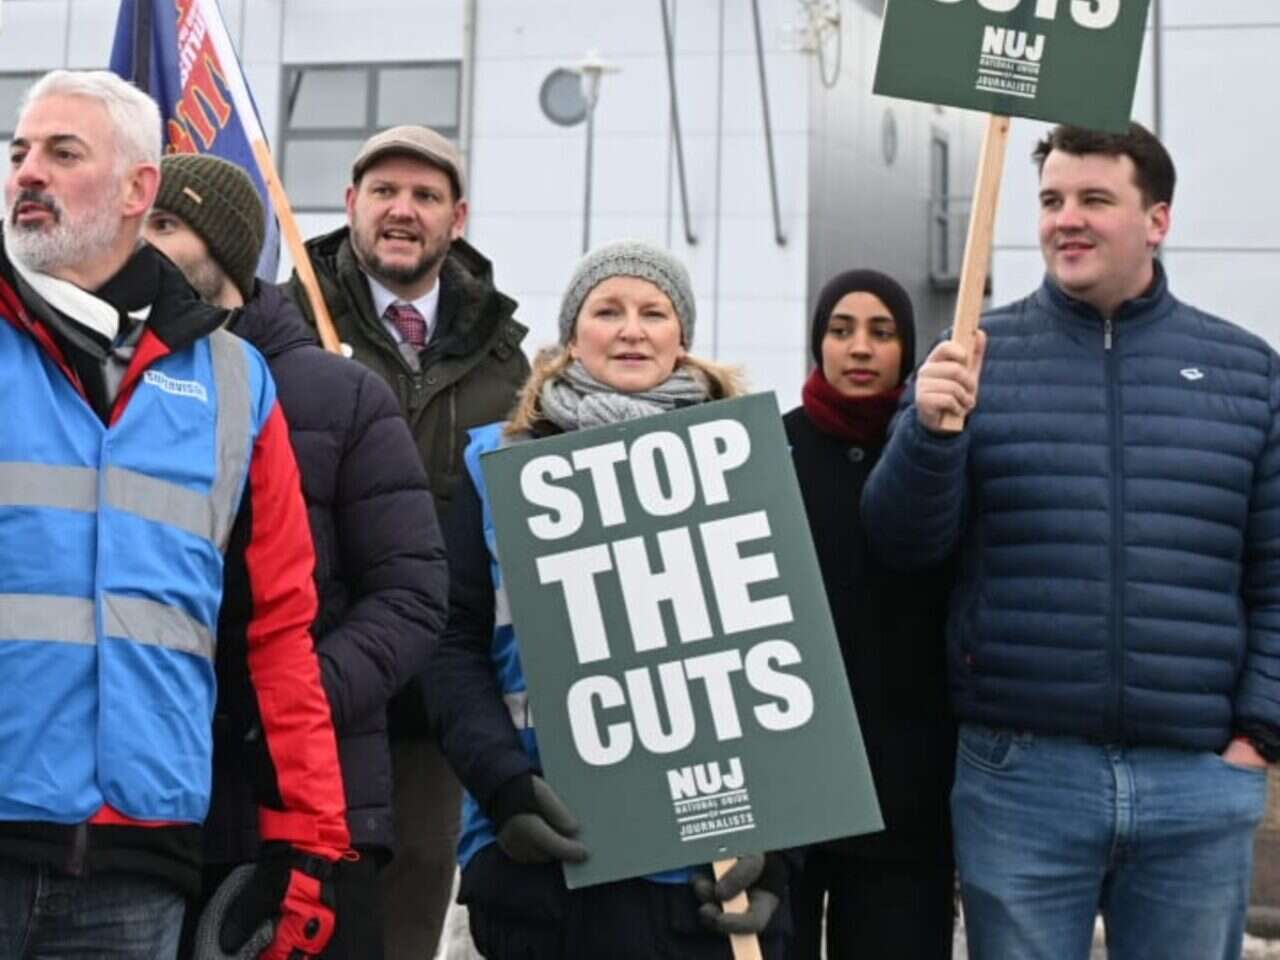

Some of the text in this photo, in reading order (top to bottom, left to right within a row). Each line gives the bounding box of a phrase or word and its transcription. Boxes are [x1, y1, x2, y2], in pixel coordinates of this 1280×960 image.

[982, 26, 1045, 61] NUJ
[520, 419, 751, 540] STOP
[536, 510, 794, 664] THE
[566, 640, 814, 766] CUTS
[667, 757, 744, 800] NUJ
